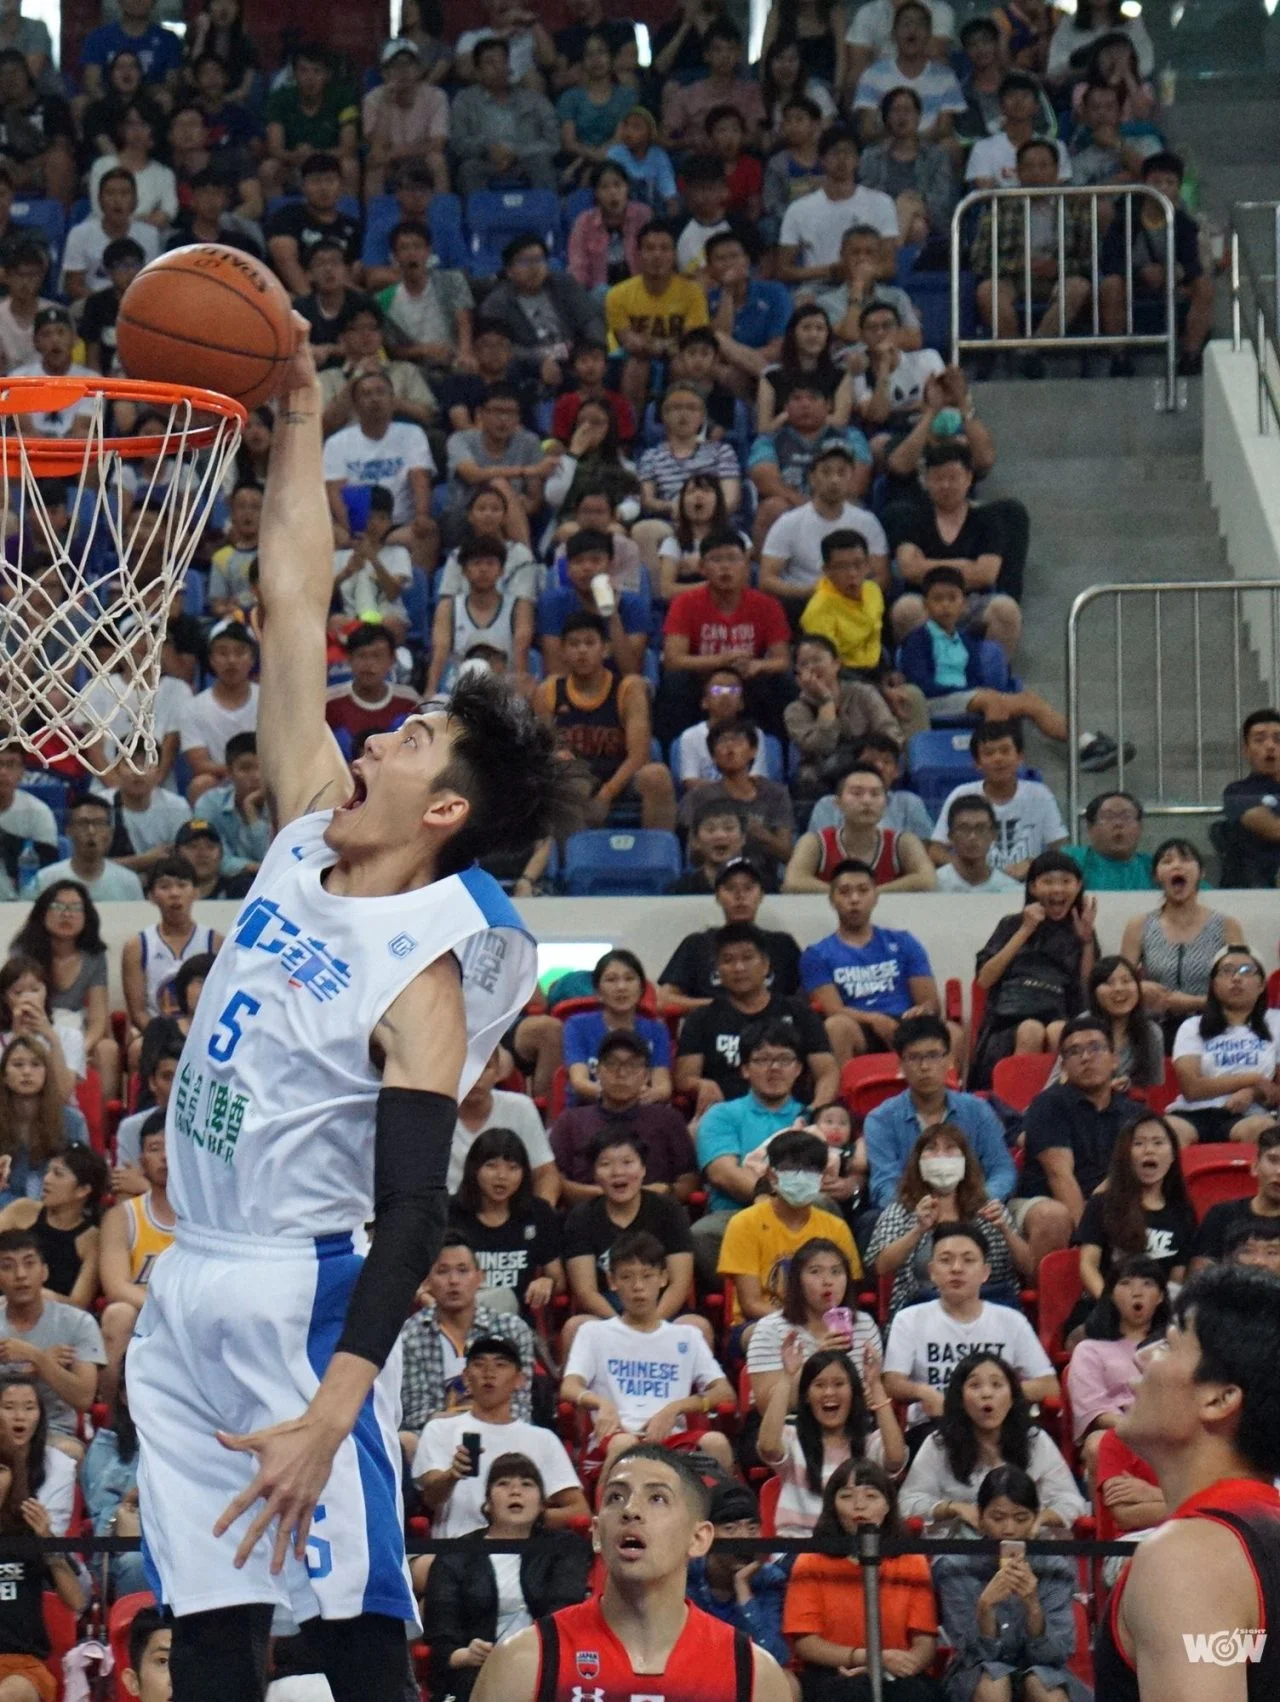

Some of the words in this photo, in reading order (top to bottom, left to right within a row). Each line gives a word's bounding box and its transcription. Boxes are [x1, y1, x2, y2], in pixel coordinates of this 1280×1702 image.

[834, 960, 901, 985] CHINESE
[845, 980, 896, 999] TAIPEI
[208, 989, 261, 1063] 5
[1214, 1053, 1259, 1068] TAIPEI
[475, 1249, 528, 1271] INESE
[482, 1268, 519, 1290] IPEI
[607, 1358, 681, 1382] CHINESE
[927, 1366, 954, 1386] BA
[618, 1377, 670, 1399] TAIPEI
